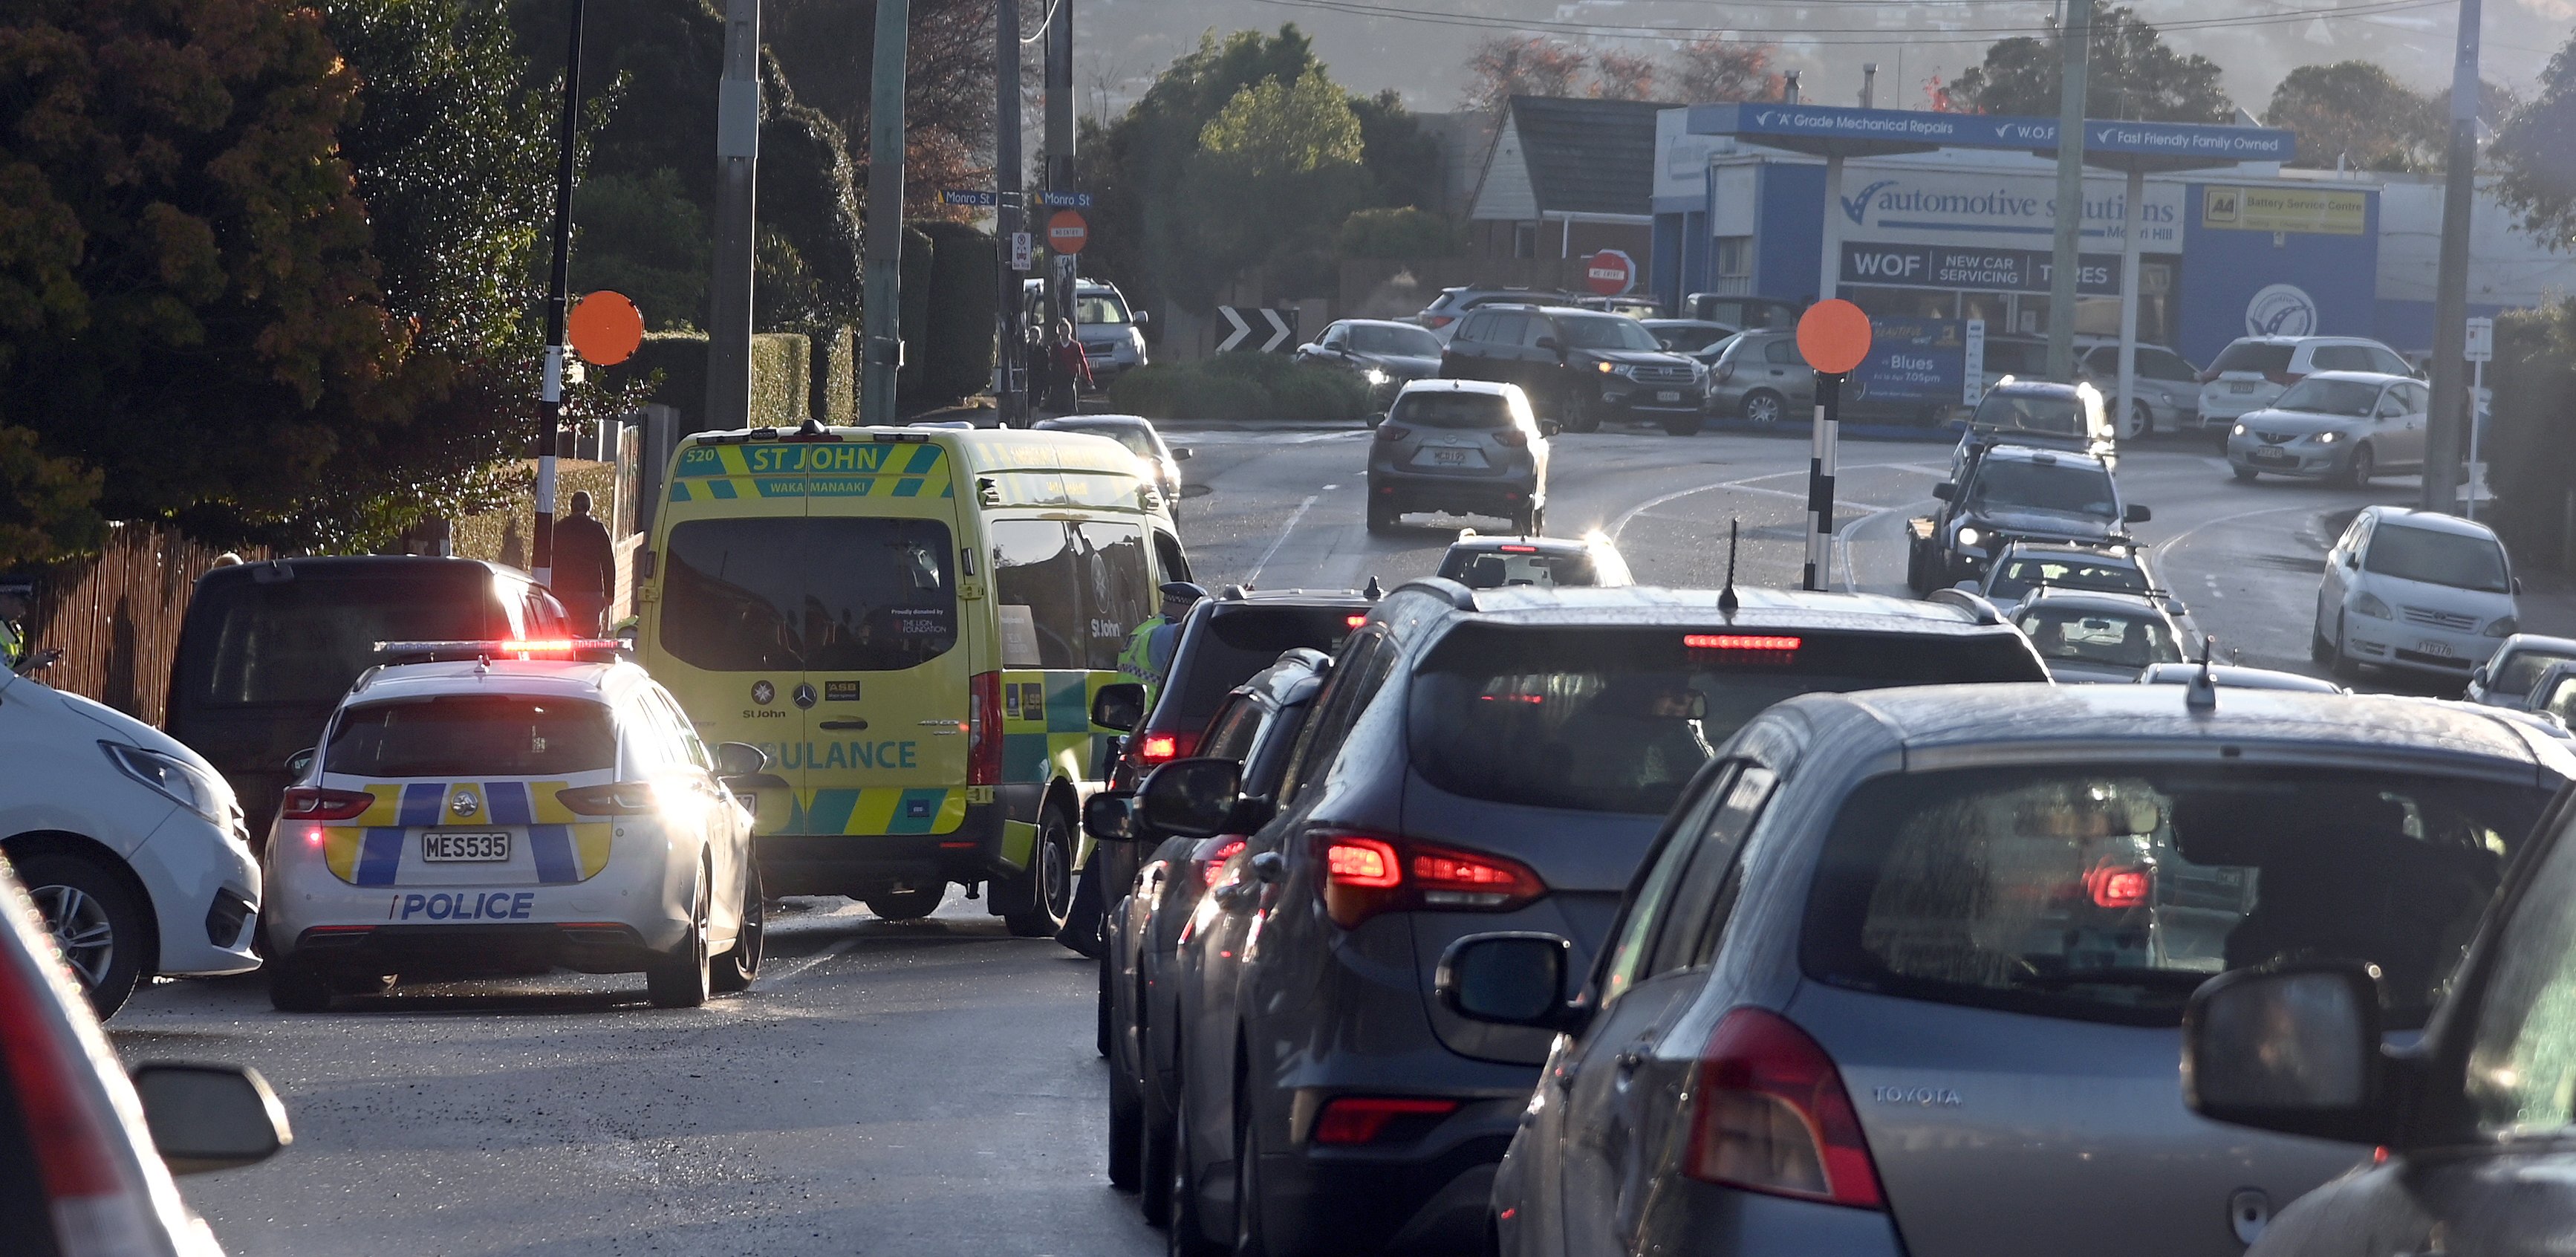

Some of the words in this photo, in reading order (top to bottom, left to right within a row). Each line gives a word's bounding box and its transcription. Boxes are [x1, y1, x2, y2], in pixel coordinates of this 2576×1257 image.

[1794, 114, 1834, 128] Grade
[1836, 116, 1907, 131] Mechanical
[1910, 120, 1954, 134] Repairs
[2118, 131, 2141, 143] Fast
[2144, 132, 2189, 149] Friendly
[2192, 134, 2230, 150] Family
[2234, 137, 2279, 151] Owned
[946, 192, 976, 204] Monro
[980, 193, 990, 204] St
[1044, 192, 1075, 205] Monro
[1079, 193, 1090, 206] St
[1878, 189, 2037, 217] automotive
[2045, 191, 2174, 223] slutins
[2247, 196, 2284, 210] Battery
[2287, 198, 2325, 210] Service
[2328, 201, 2362, 211] Centre
[2107, 225, 2148, 238] Mri
[2152, 227, 2173, 240] Hill
[1855, 253, 1920, 276] WOF
[1946, 255, 1980, 267] NEW
[1983, 256, 2014, 270] CAR
[1939, 269, 2018, 284] SERVICING
[1891, 354, 1933, 370] Blues
[686, 449, 715, 463] 520
[753, 447, 788, 470] ST
[793, 447, 878, 470] JOHN
[770, 482, 804, 493] WAKA
[809, 482, 865, 493] MANAAKI
[1090, 618, 1100, 638] St
[1101, 619, 1121, 637] John
[827, 683, 856, 692] ASB
[743, 709, 755, 718] St
[757, 709, 786, 718] John
[708, 741, 917, 770] BULANCE
[426, 837, 506, 857] MES535
[401, 893, 535, 920] POLICE
[1874, 1085, 1962, 1106] TOYOTA
